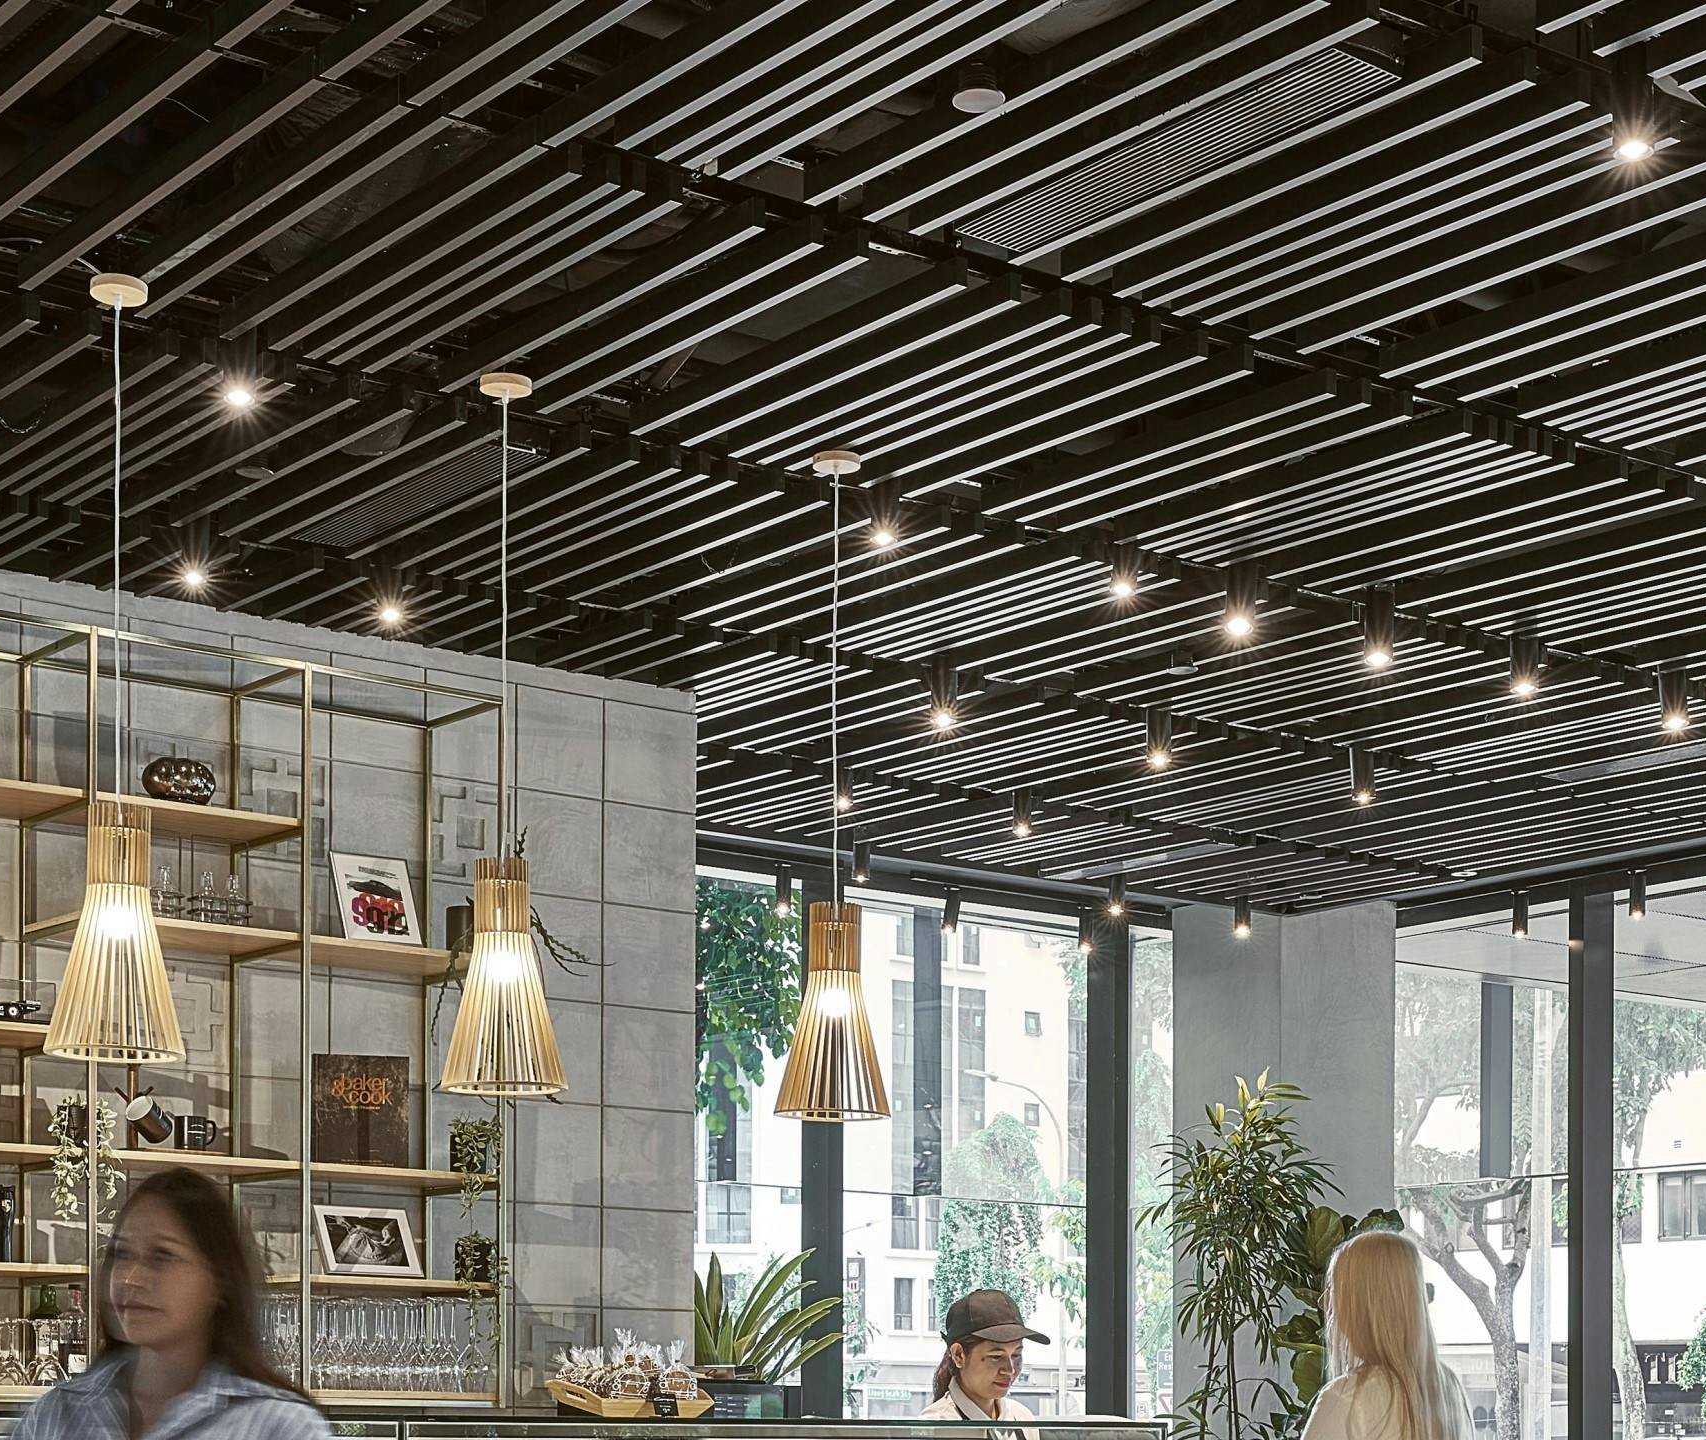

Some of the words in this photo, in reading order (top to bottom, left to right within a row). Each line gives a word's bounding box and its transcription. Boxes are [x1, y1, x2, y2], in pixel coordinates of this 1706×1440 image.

[332, 1079, 350, 1103] &
[349, 1090, 393, 1105] cook
[341, 1073, 389, 1091] baker
